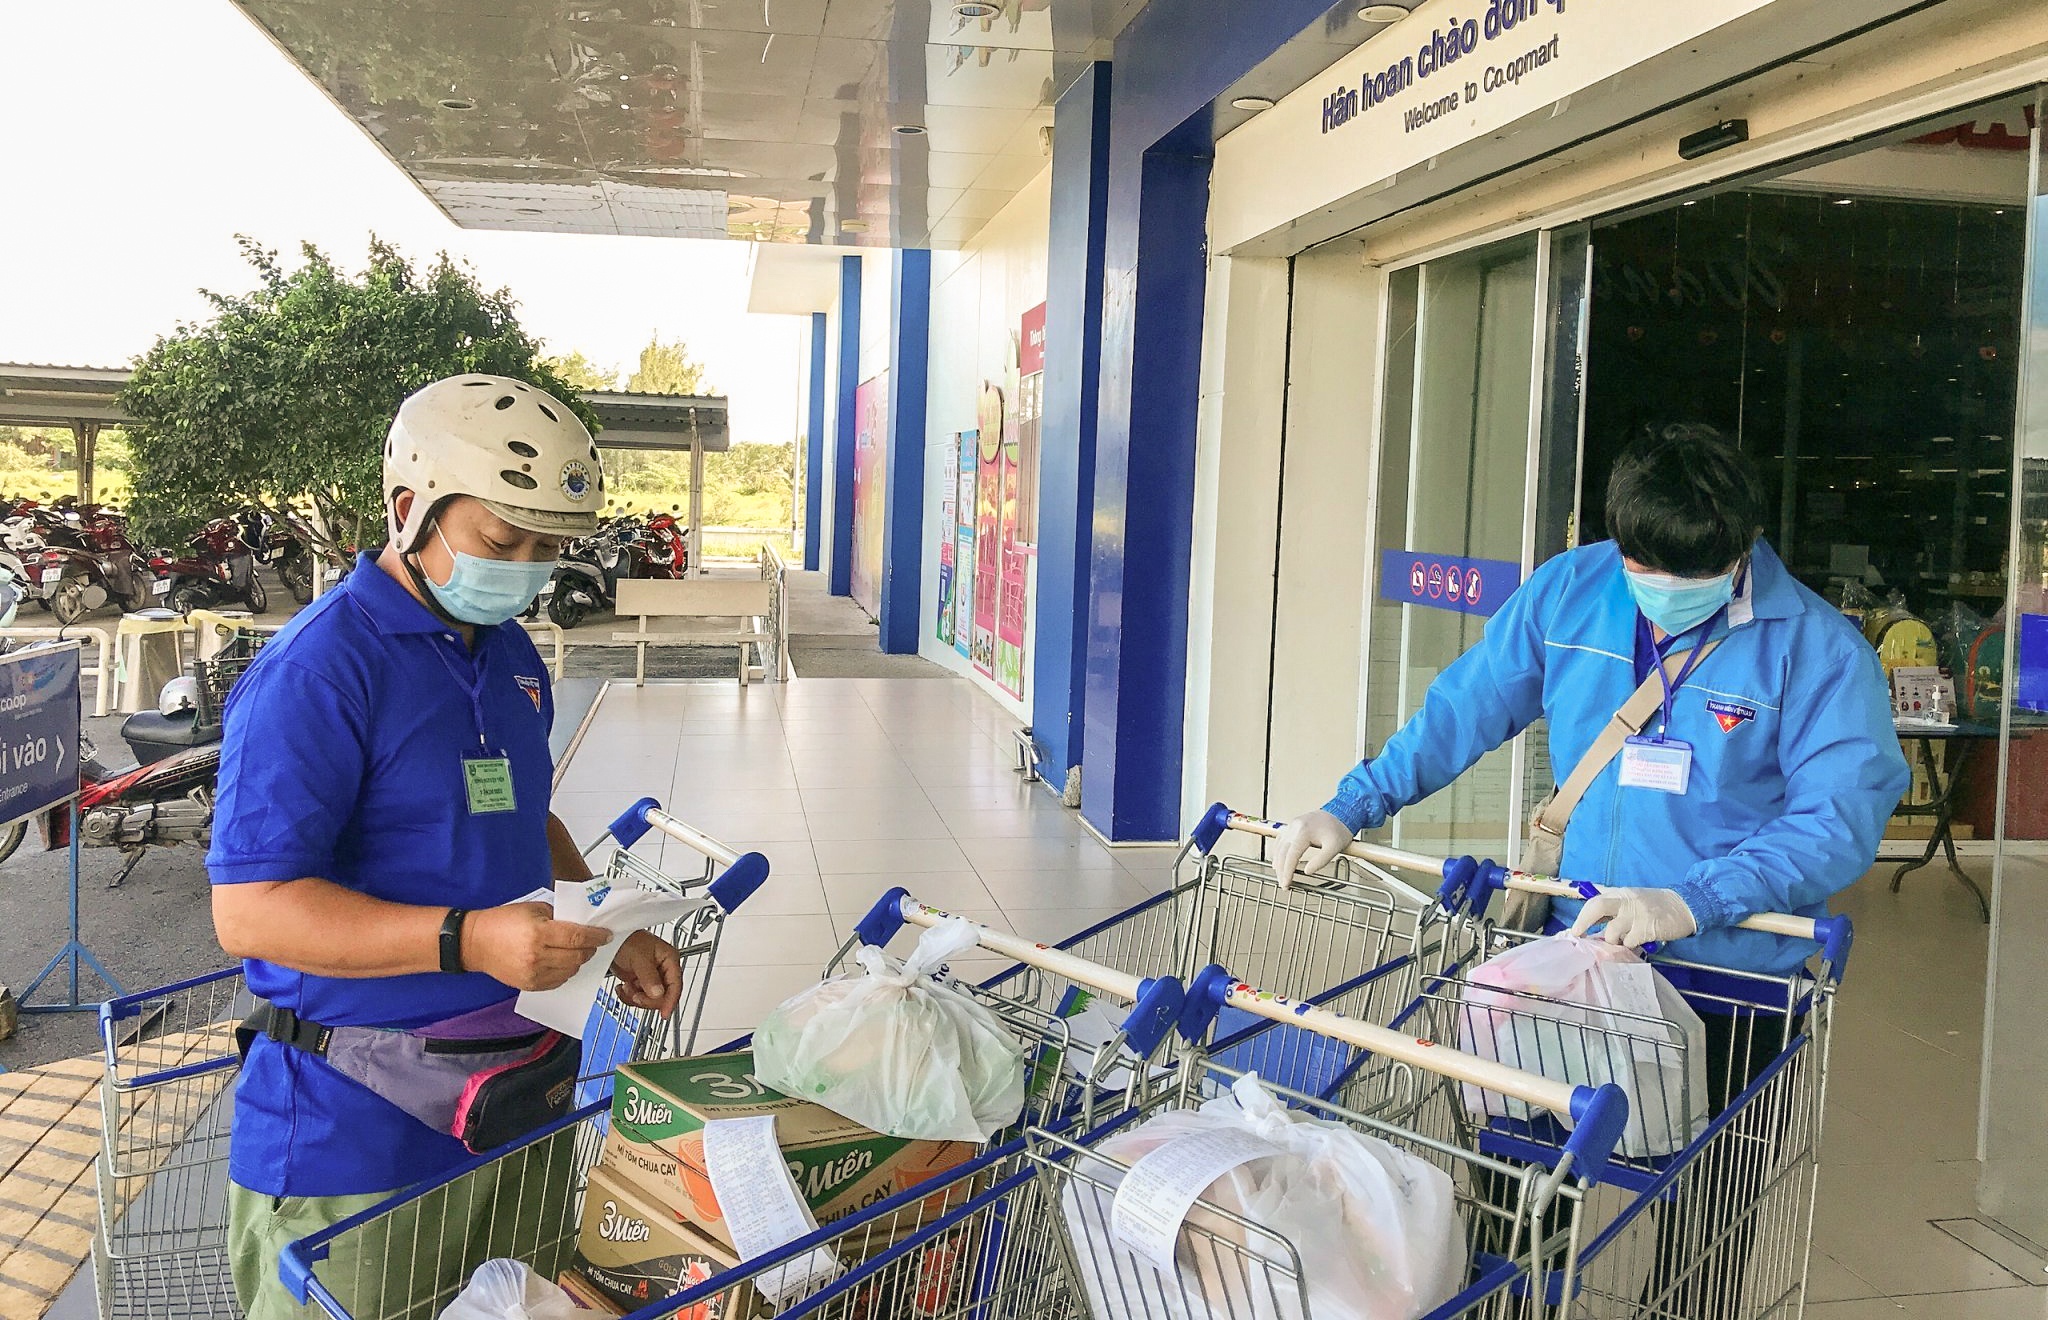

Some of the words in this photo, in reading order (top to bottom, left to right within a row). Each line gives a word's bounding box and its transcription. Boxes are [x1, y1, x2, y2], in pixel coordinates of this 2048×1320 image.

[1322, 86, 1358, 134] Hân
[1362, 55, 1414, 112] hoan
[1417, 17, 1479, 79] chào
[1404, 91, 1459, 133] Welcome
[1464, 82, 1478, 104] to
[1483, 33, 1559, 93] Co.opmart
[13, 733, 47, 770] vào
[756, 1102, 797, 1111] CHUA
[624, 1150, 638, 1165] TÔM
[638, 1157, 659, 1174] CHUA
[660, 1163, 677, 1177] CAY
[861, 1179, 893, 1209] CAY
[658, 1259, 678, 1277] GOLD
[593, 1270, 605, 1284] TÔM
[604, 1277, 620, 1292] CHUA
[620, 1283, 633, 1295] CAY
